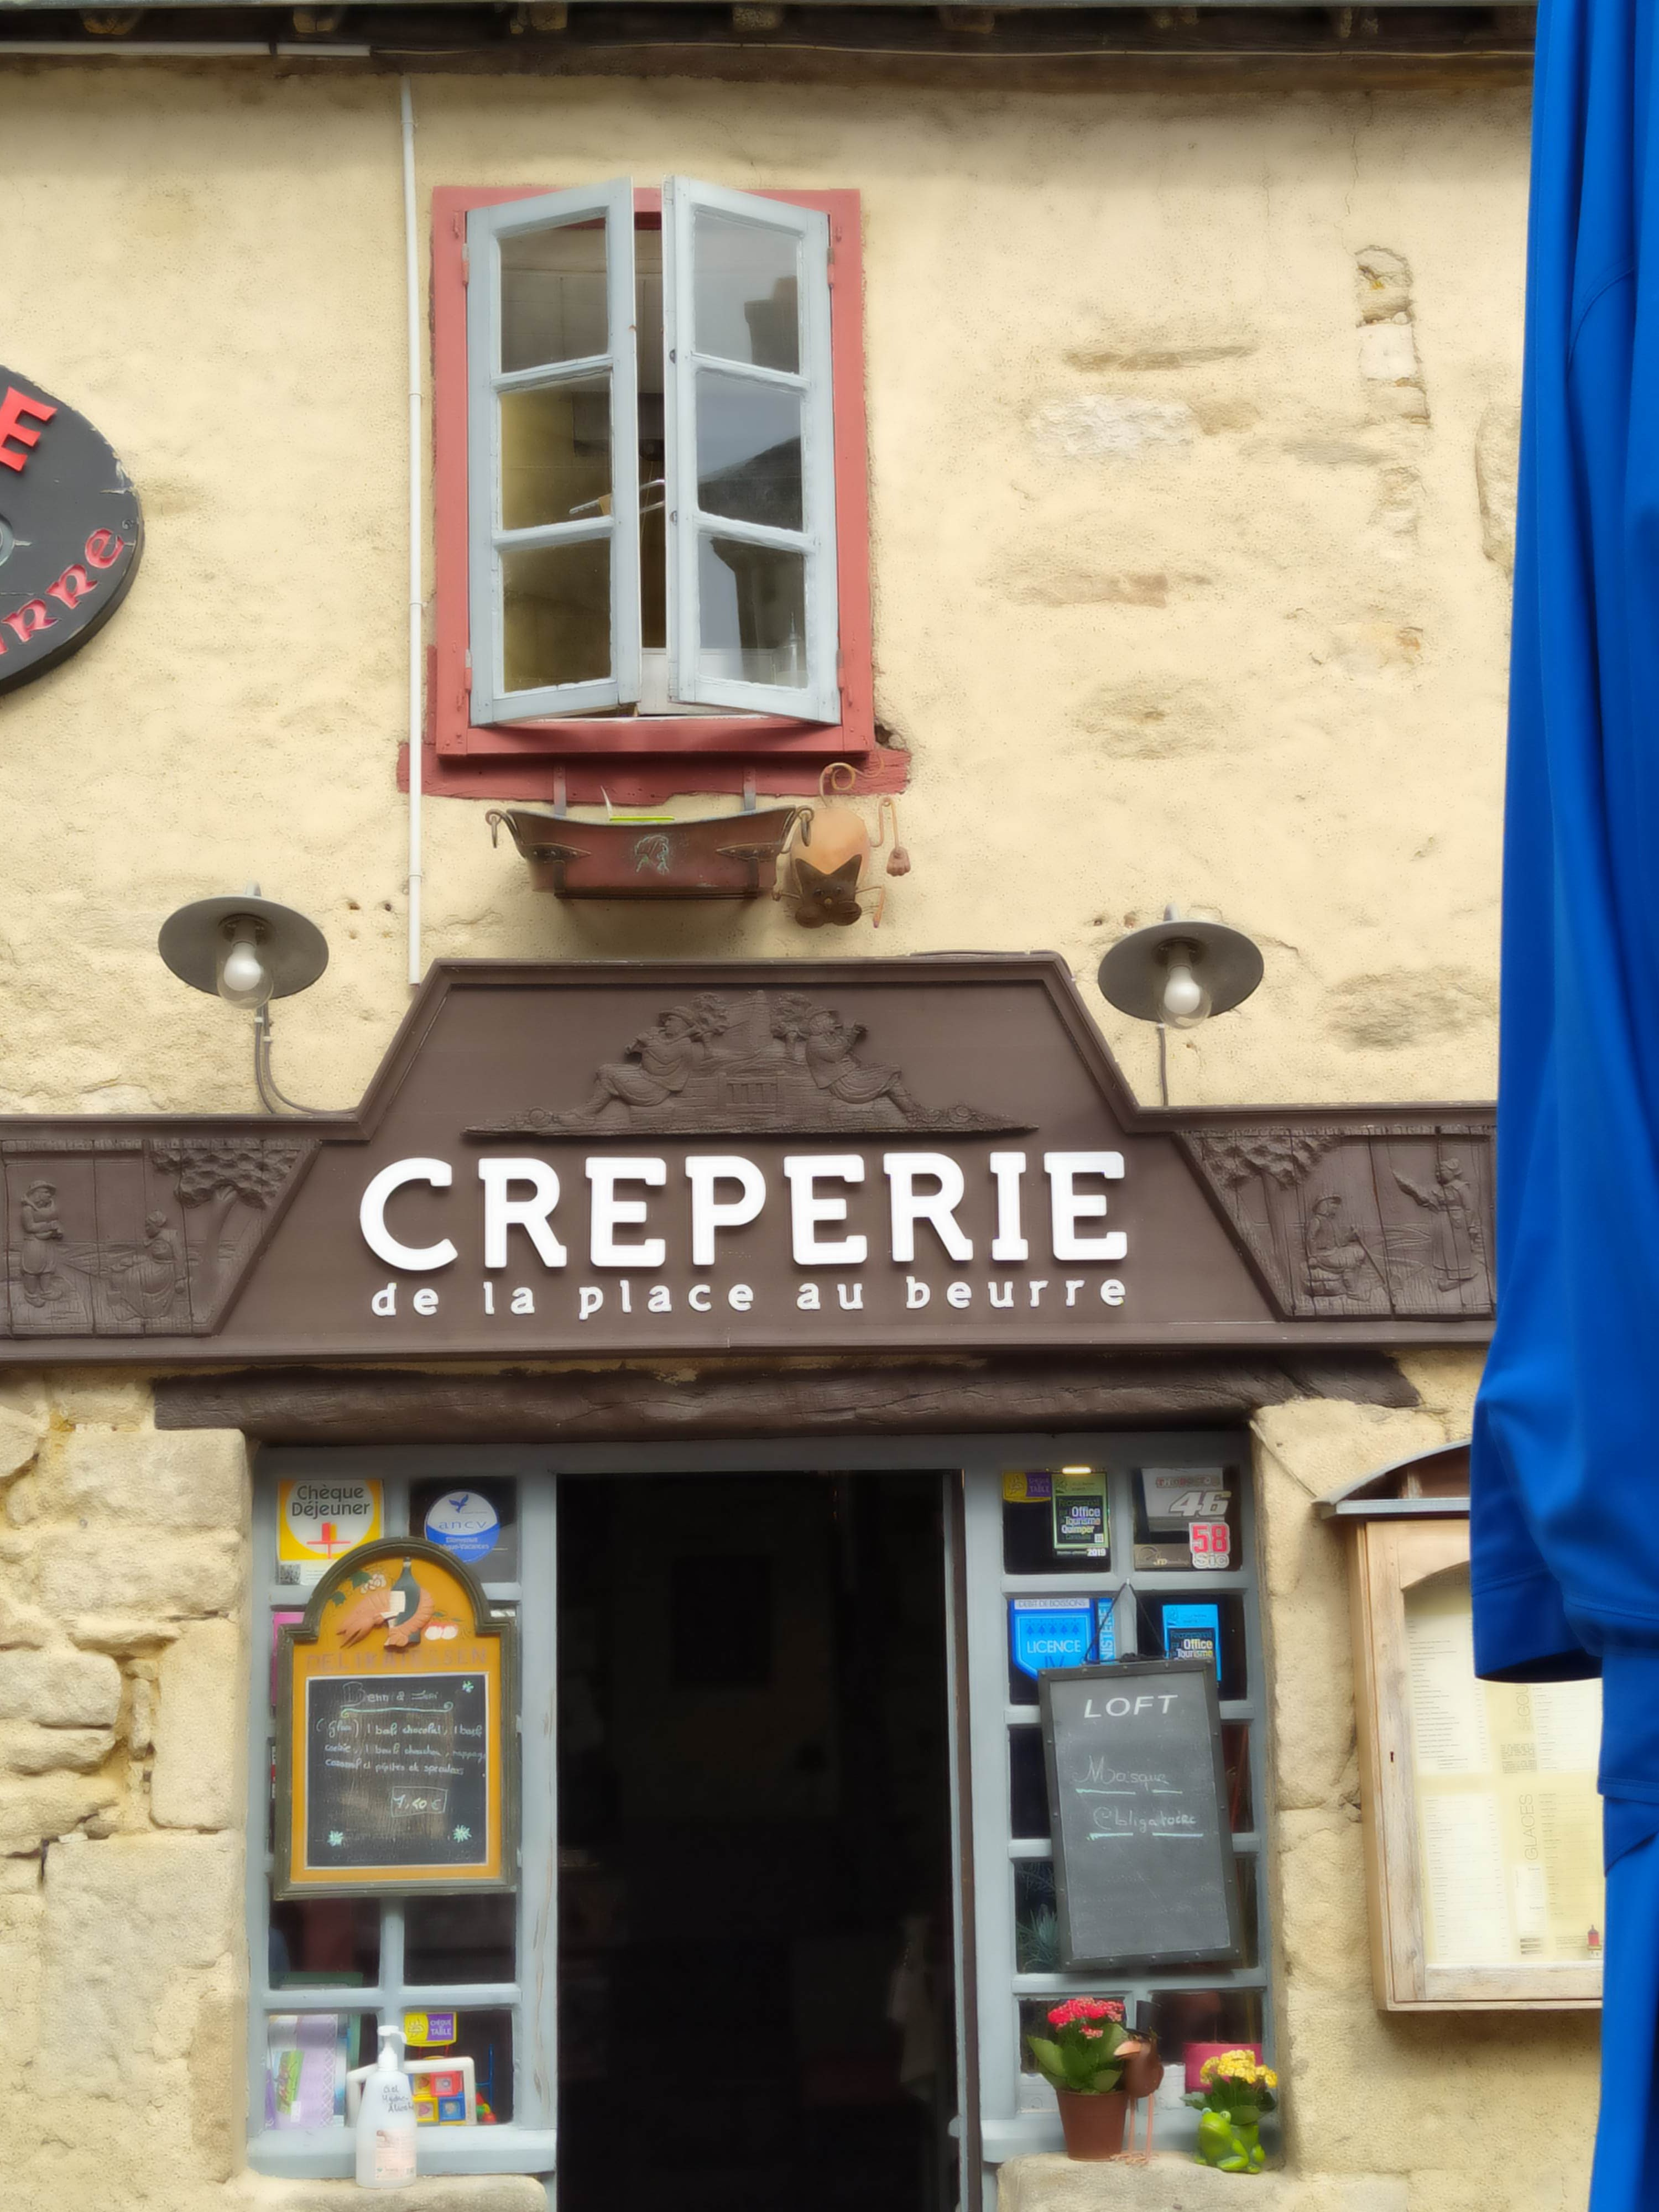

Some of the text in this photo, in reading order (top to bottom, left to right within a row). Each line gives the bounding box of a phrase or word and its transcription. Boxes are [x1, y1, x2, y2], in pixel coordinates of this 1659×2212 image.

[358, 1150, 1129, 1271] CREPERIE
[371, 1275, 1126, 1321] de la place au beurre
[297, 1484, 364, 1502] Chèque
[1168, 1490, 1232, 1517] 46
[292, 1501, 371, 1520] Déjeuner
[439, 1521, 487, 1530] ancv
[1061, 1525, 1094, 1535] Quimper
[1192, 1524, 1228, 1553] 58
[1087, 1548, 1106, 1557] 2019
[1027, 1639, 1082, 1654] LICENCE
[305, 1647, 487, 1671] DELIKATESSEN
[1084, 1694, 1179, 1719] LOFT
[1073, 1754, 1170, 1791] Masque
[1519, 1793, 1538, 1860] GLACES
[430, 2028, 452, 2036] TABLE
